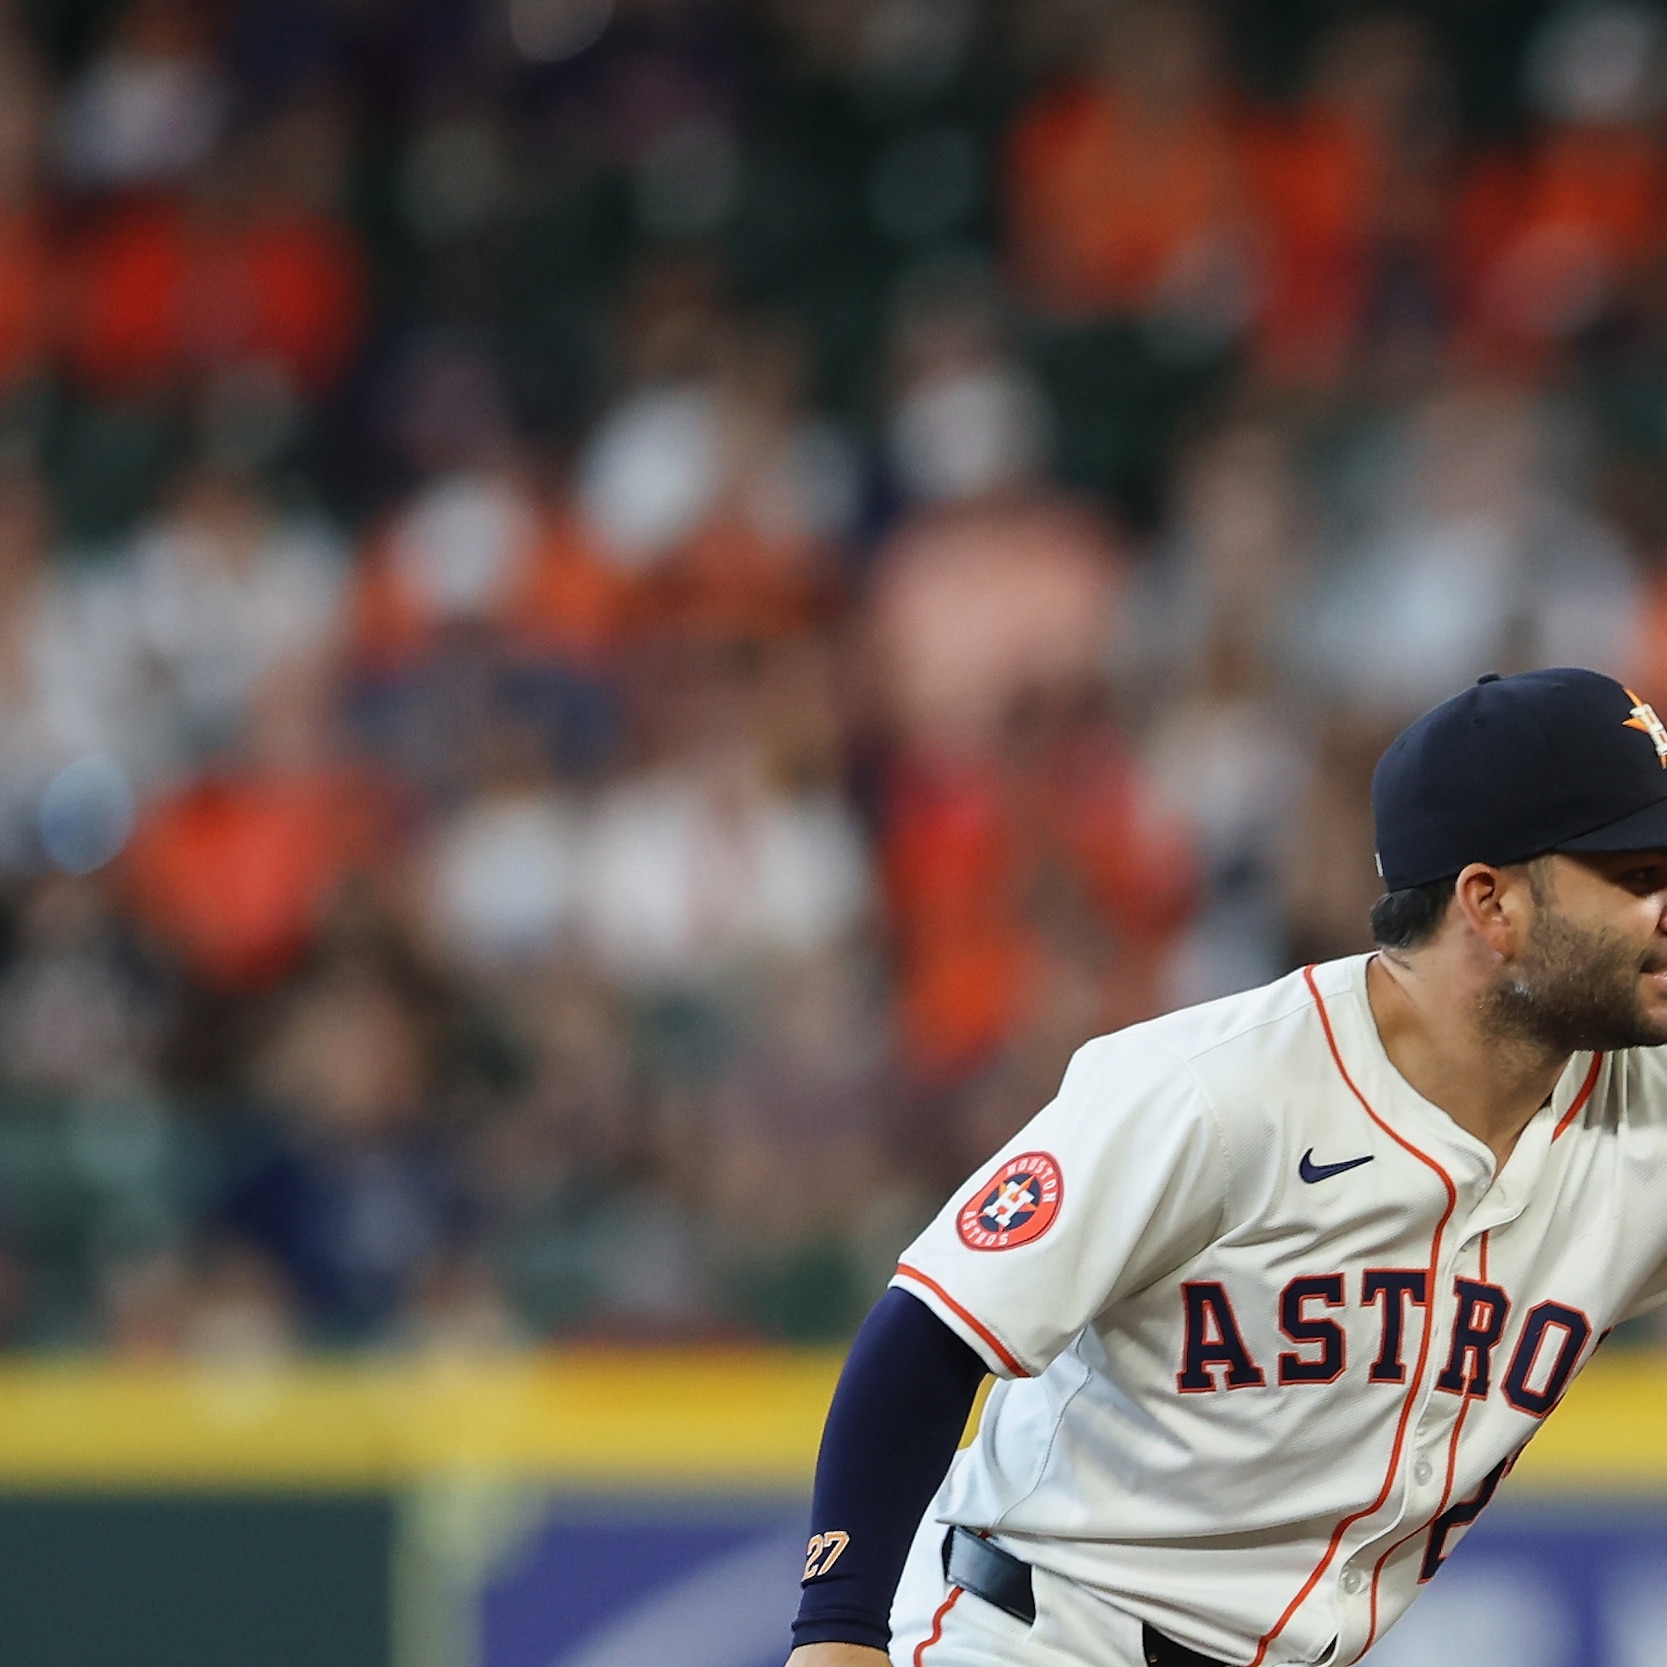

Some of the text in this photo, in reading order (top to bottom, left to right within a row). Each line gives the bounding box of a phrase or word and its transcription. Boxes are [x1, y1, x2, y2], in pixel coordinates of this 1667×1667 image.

[1006, 1158, 1057, 1203] HOUSTON
[962, 1210, 1010, 1246] ASTROS
[1177, 1267, 1612, 1418] ASTRO
[801, 1530, 850, 1582] 27
